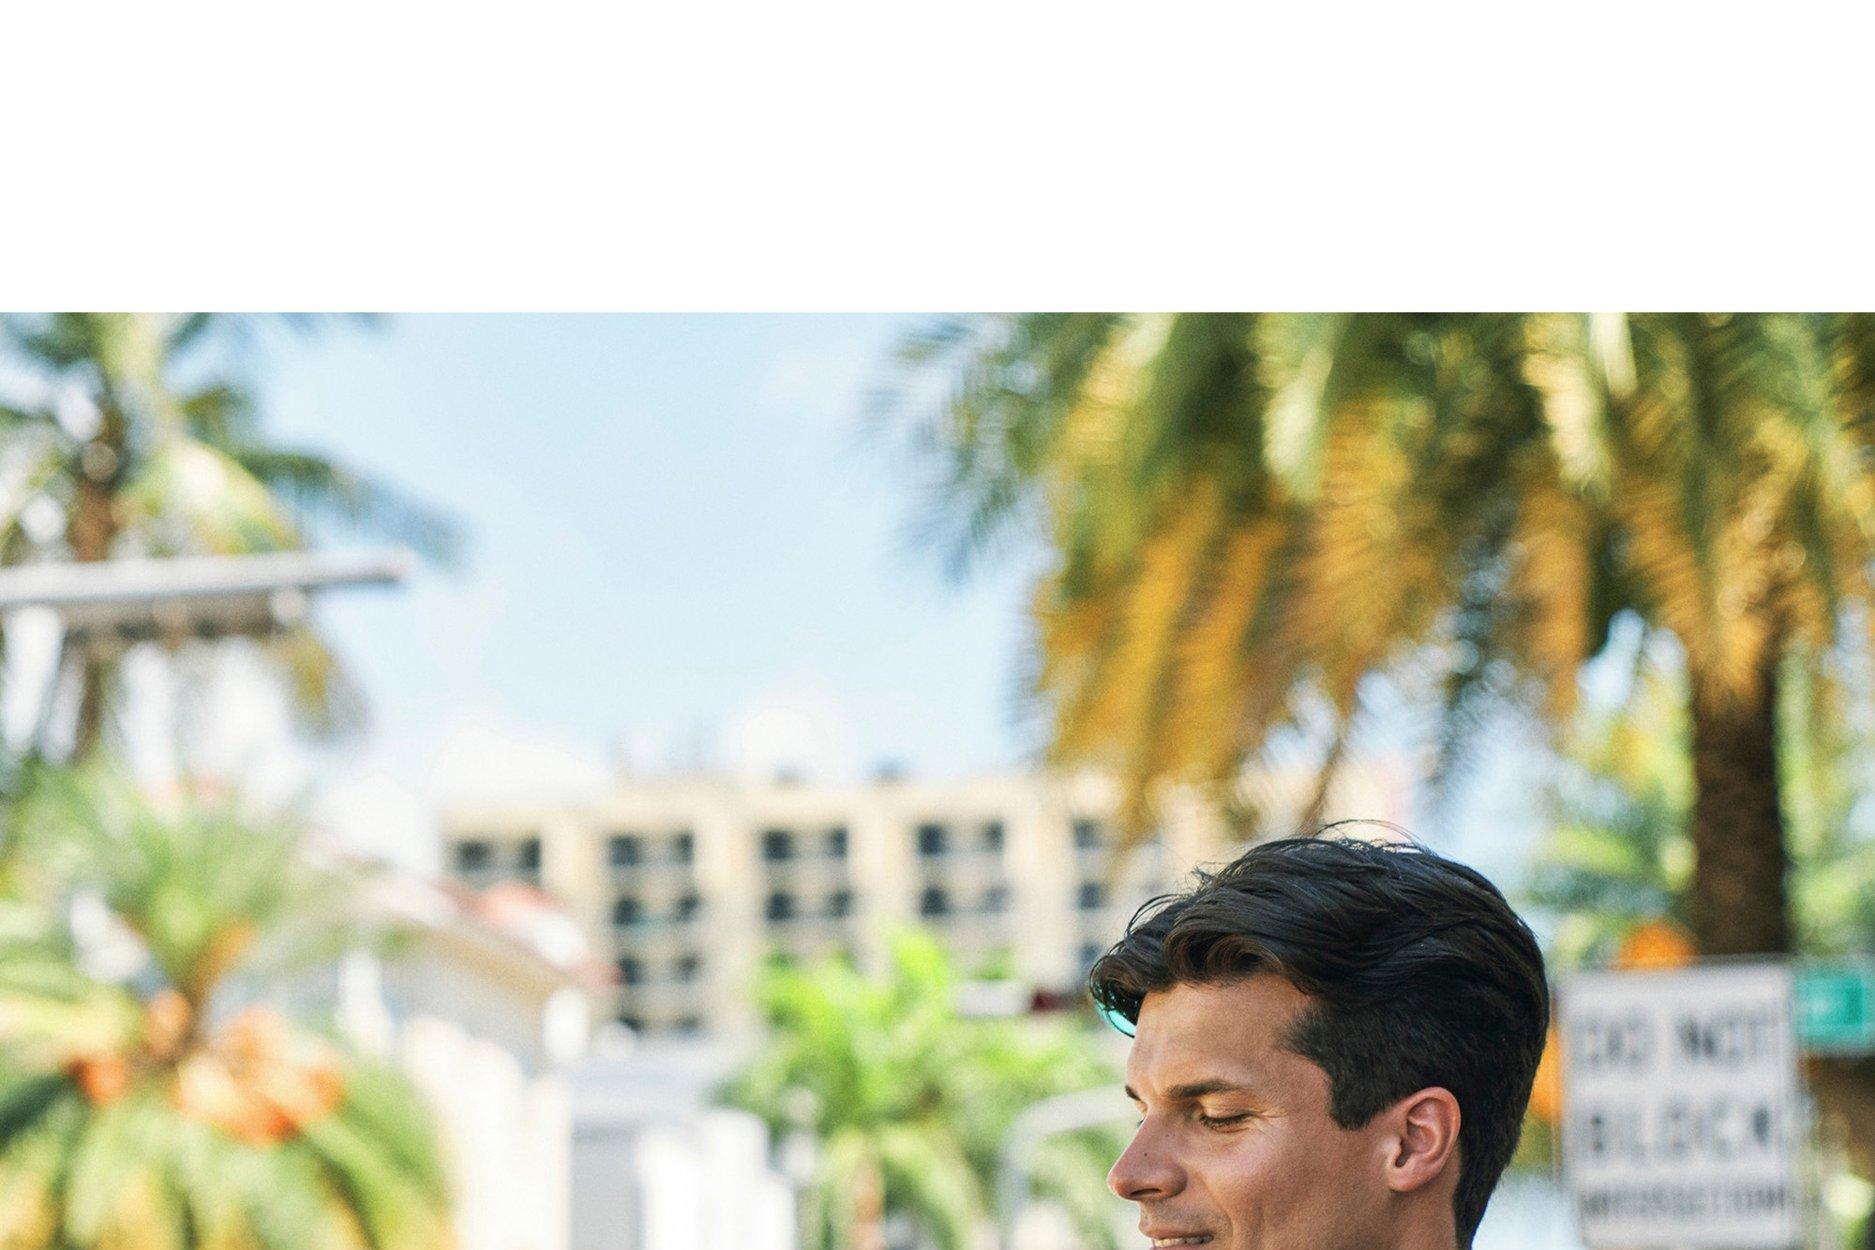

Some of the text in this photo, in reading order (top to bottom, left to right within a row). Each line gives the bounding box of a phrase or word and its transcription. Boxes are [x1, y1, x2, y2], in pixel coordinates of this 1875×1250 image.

[1571, 1005, 1784, 1070] DO NOT
[1573, 1095, 1788, 1160] BLOCK
